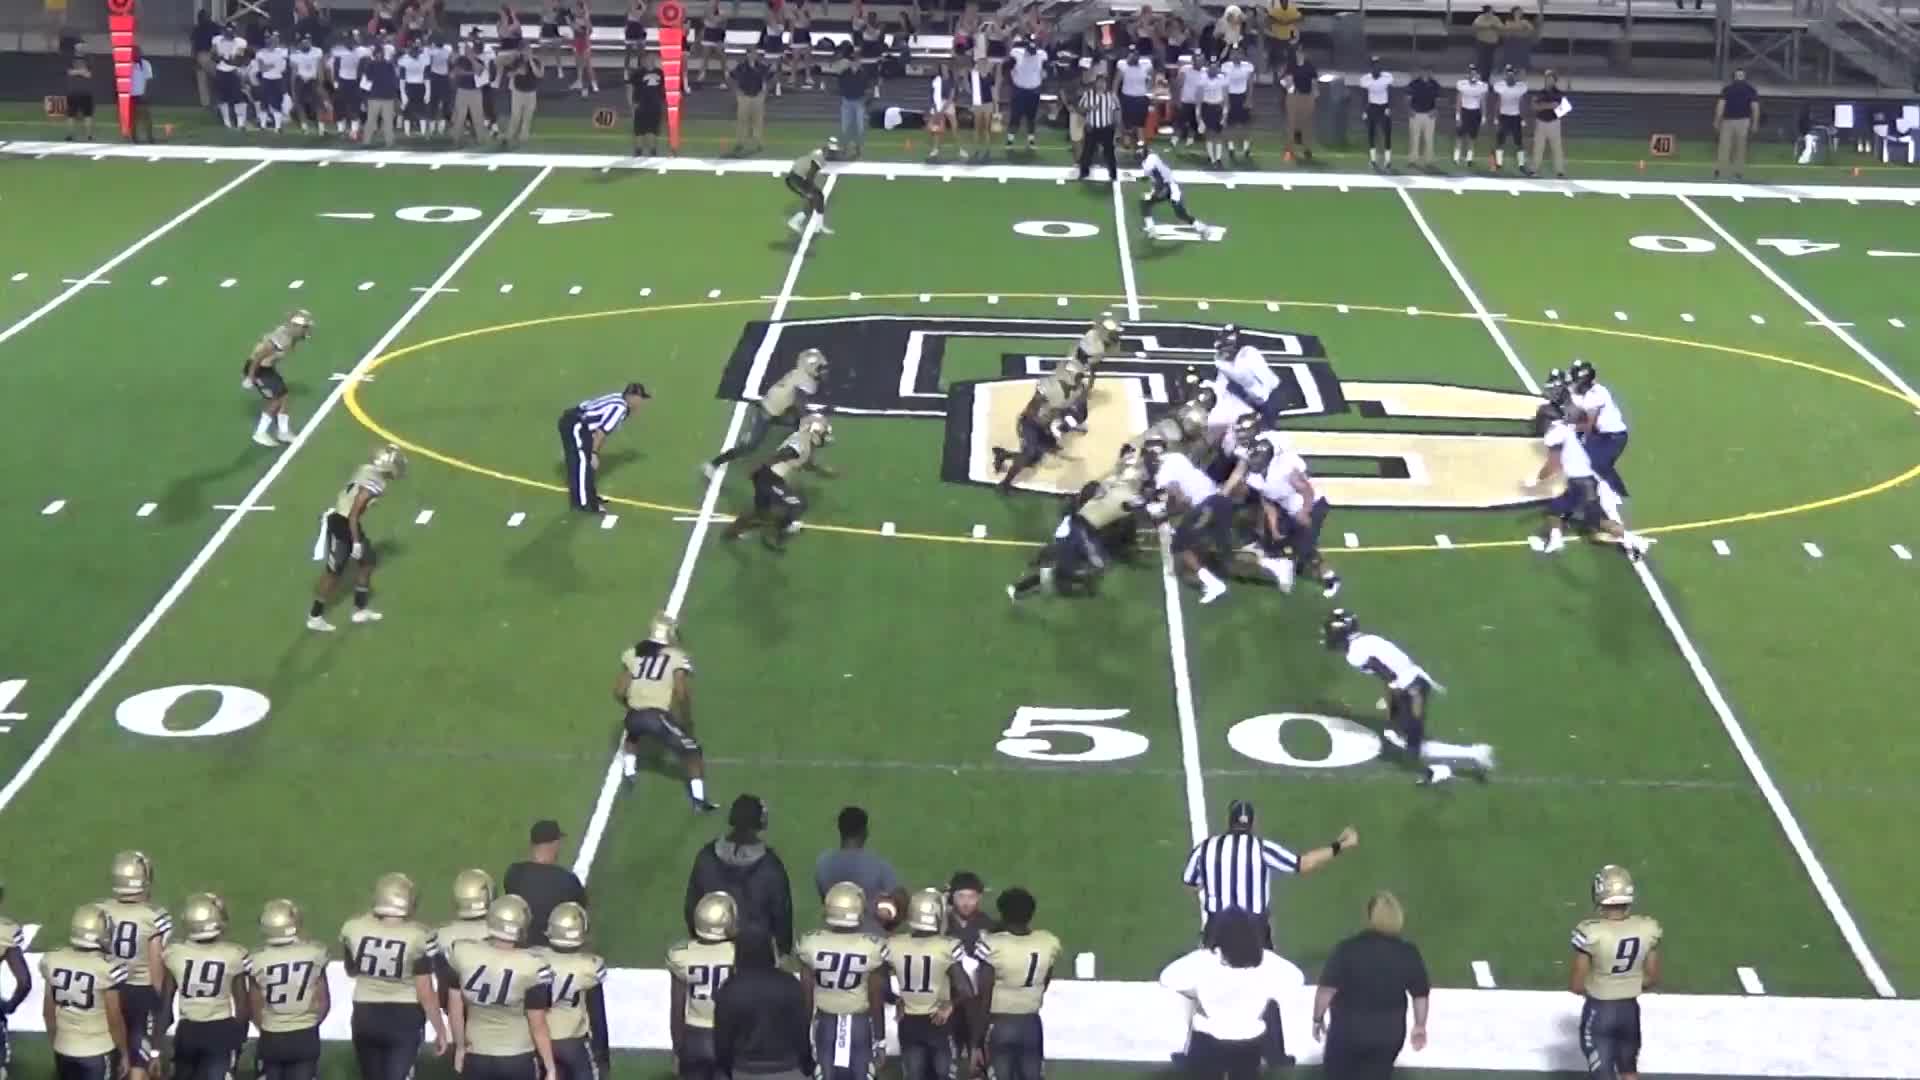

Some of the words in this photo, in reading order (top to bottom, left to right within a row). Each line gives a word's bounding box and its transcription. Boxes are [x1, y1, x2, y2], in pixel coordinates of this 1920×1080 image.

[1653, 136, 1672, 153] 40
[108, 916, 139, 960] 8
[359, 935, 407, 980] 63
[1610, 937, 1641, 976] 9
[52, 967, 96, 1010] 23
[181, 959, 226, 999] 19
[266, 960, 315, 1005] 27
[463, 964, 515, 1006] 41
[815, 951, 868, 991] 26
[902, 954, 934, 993] 11
[1023, 951, 1040, 988] 1
[552, 973, 580, 1008] 4
